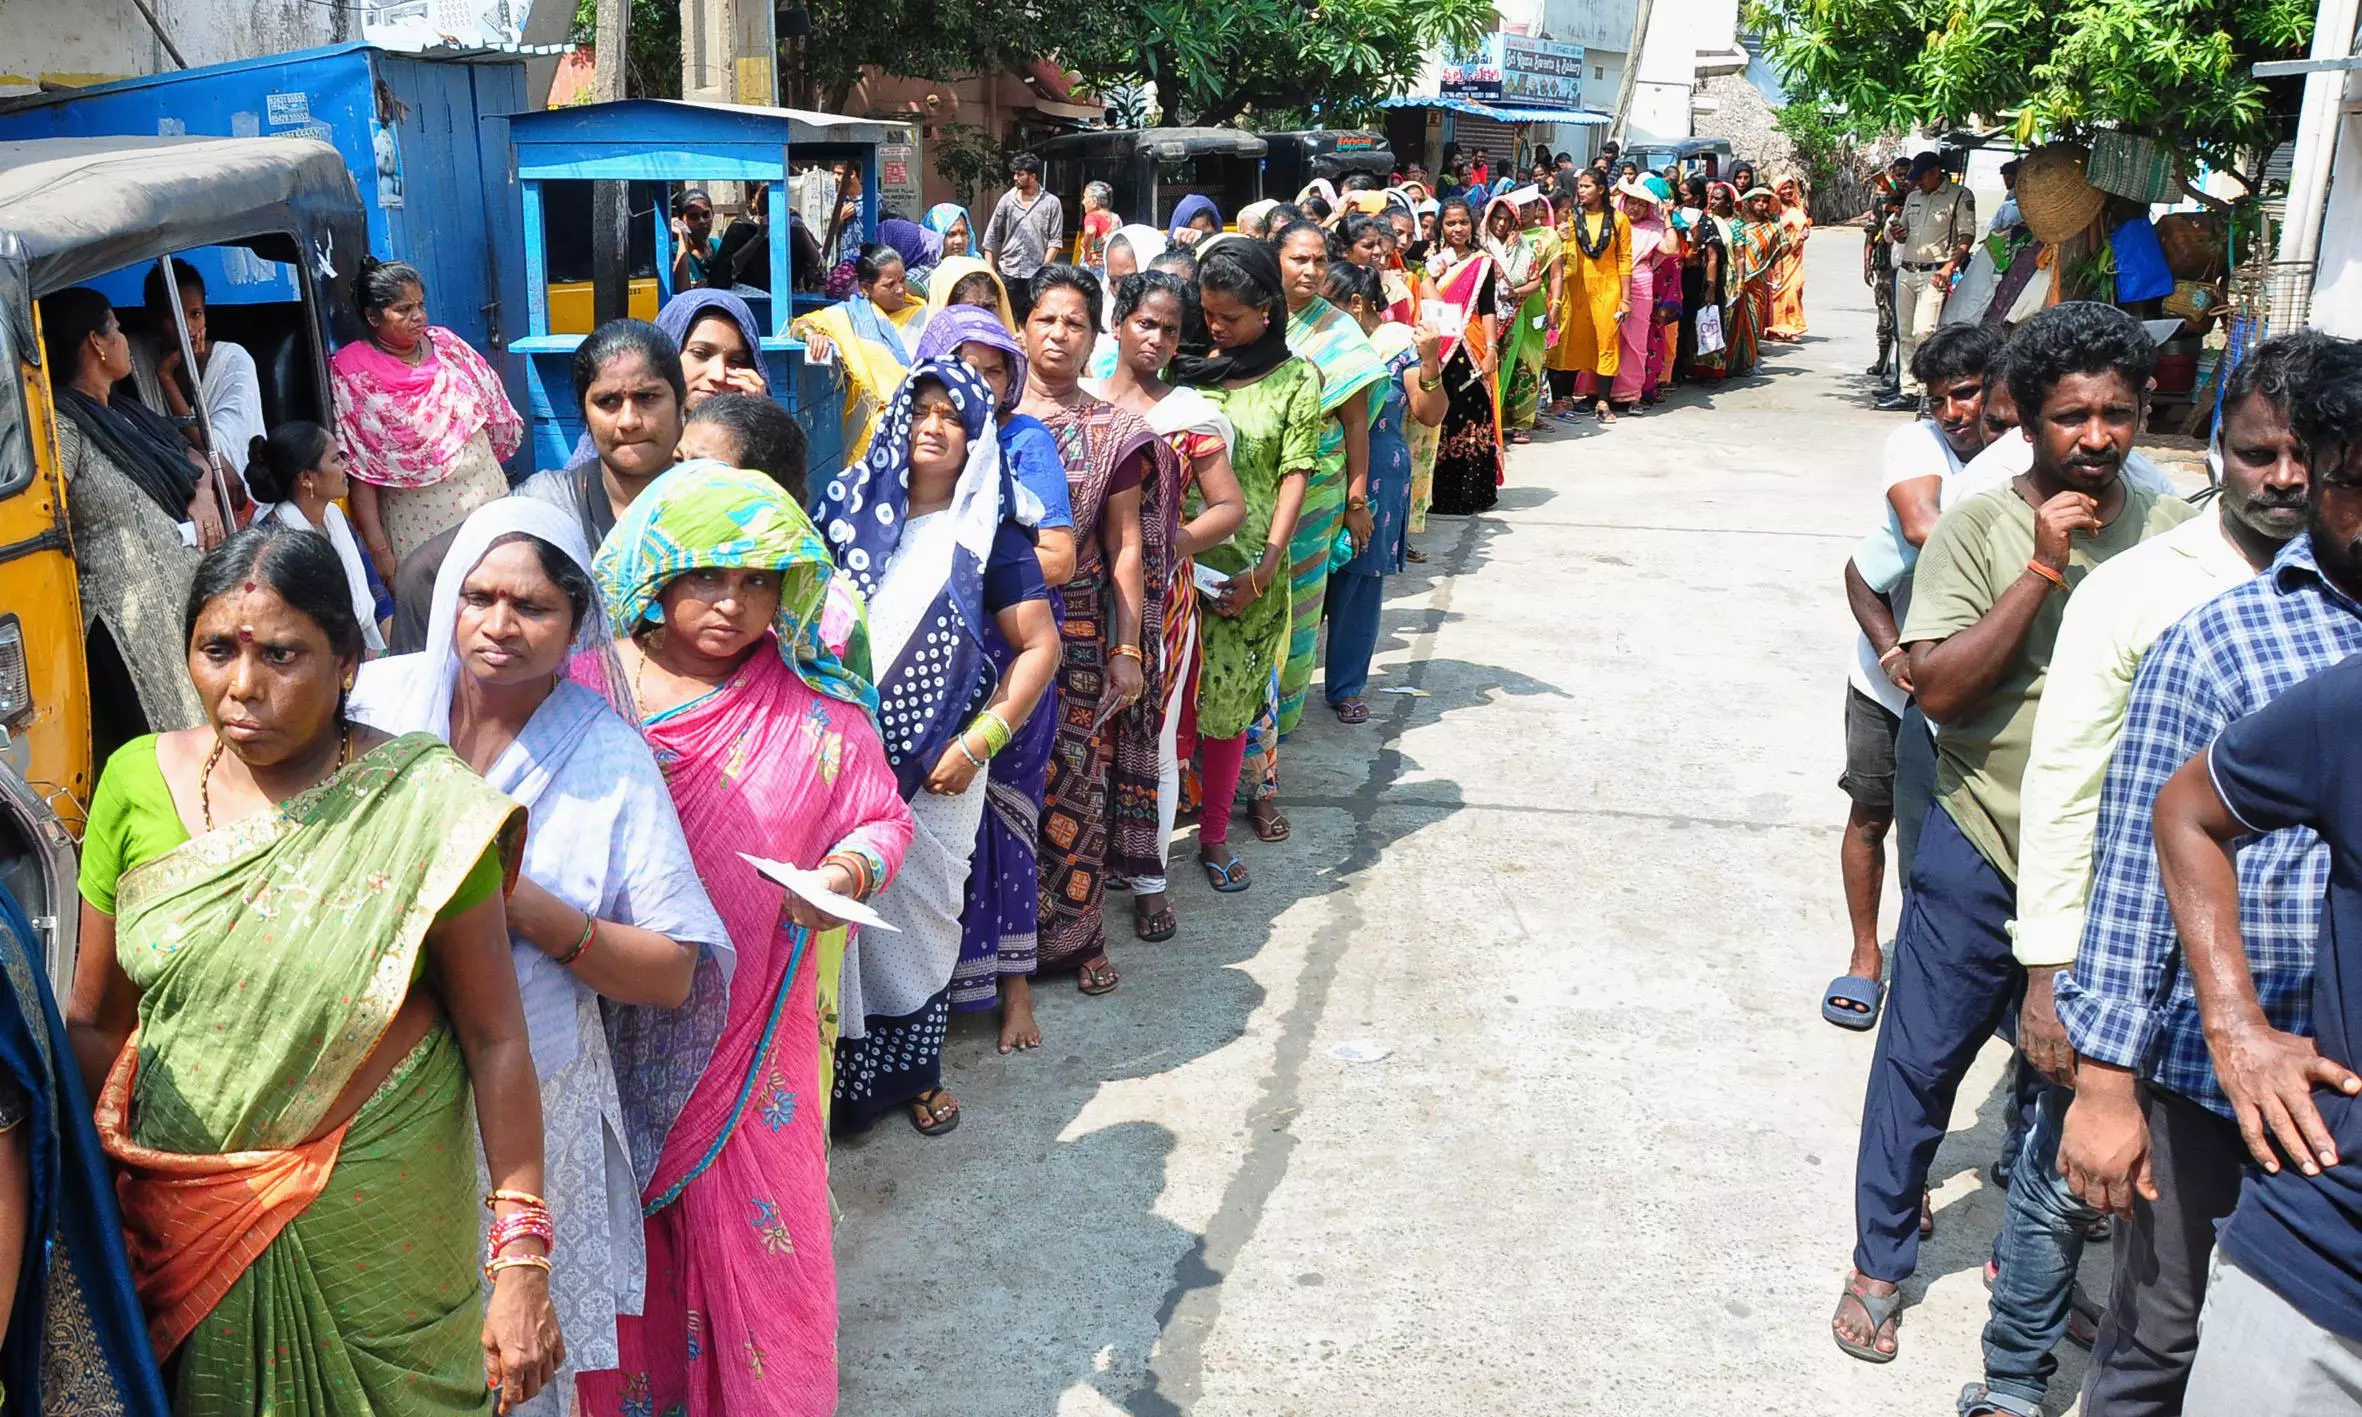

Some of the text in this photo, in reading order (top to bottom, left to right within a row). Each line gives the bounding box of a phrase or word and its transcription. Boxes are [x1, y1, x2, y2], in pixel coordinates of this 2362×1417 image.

[1506, 50, 1516, 68] Sri
[1517, 51, 1533, 70] Rama
[1561, 58, 1581, 76] Bakery
